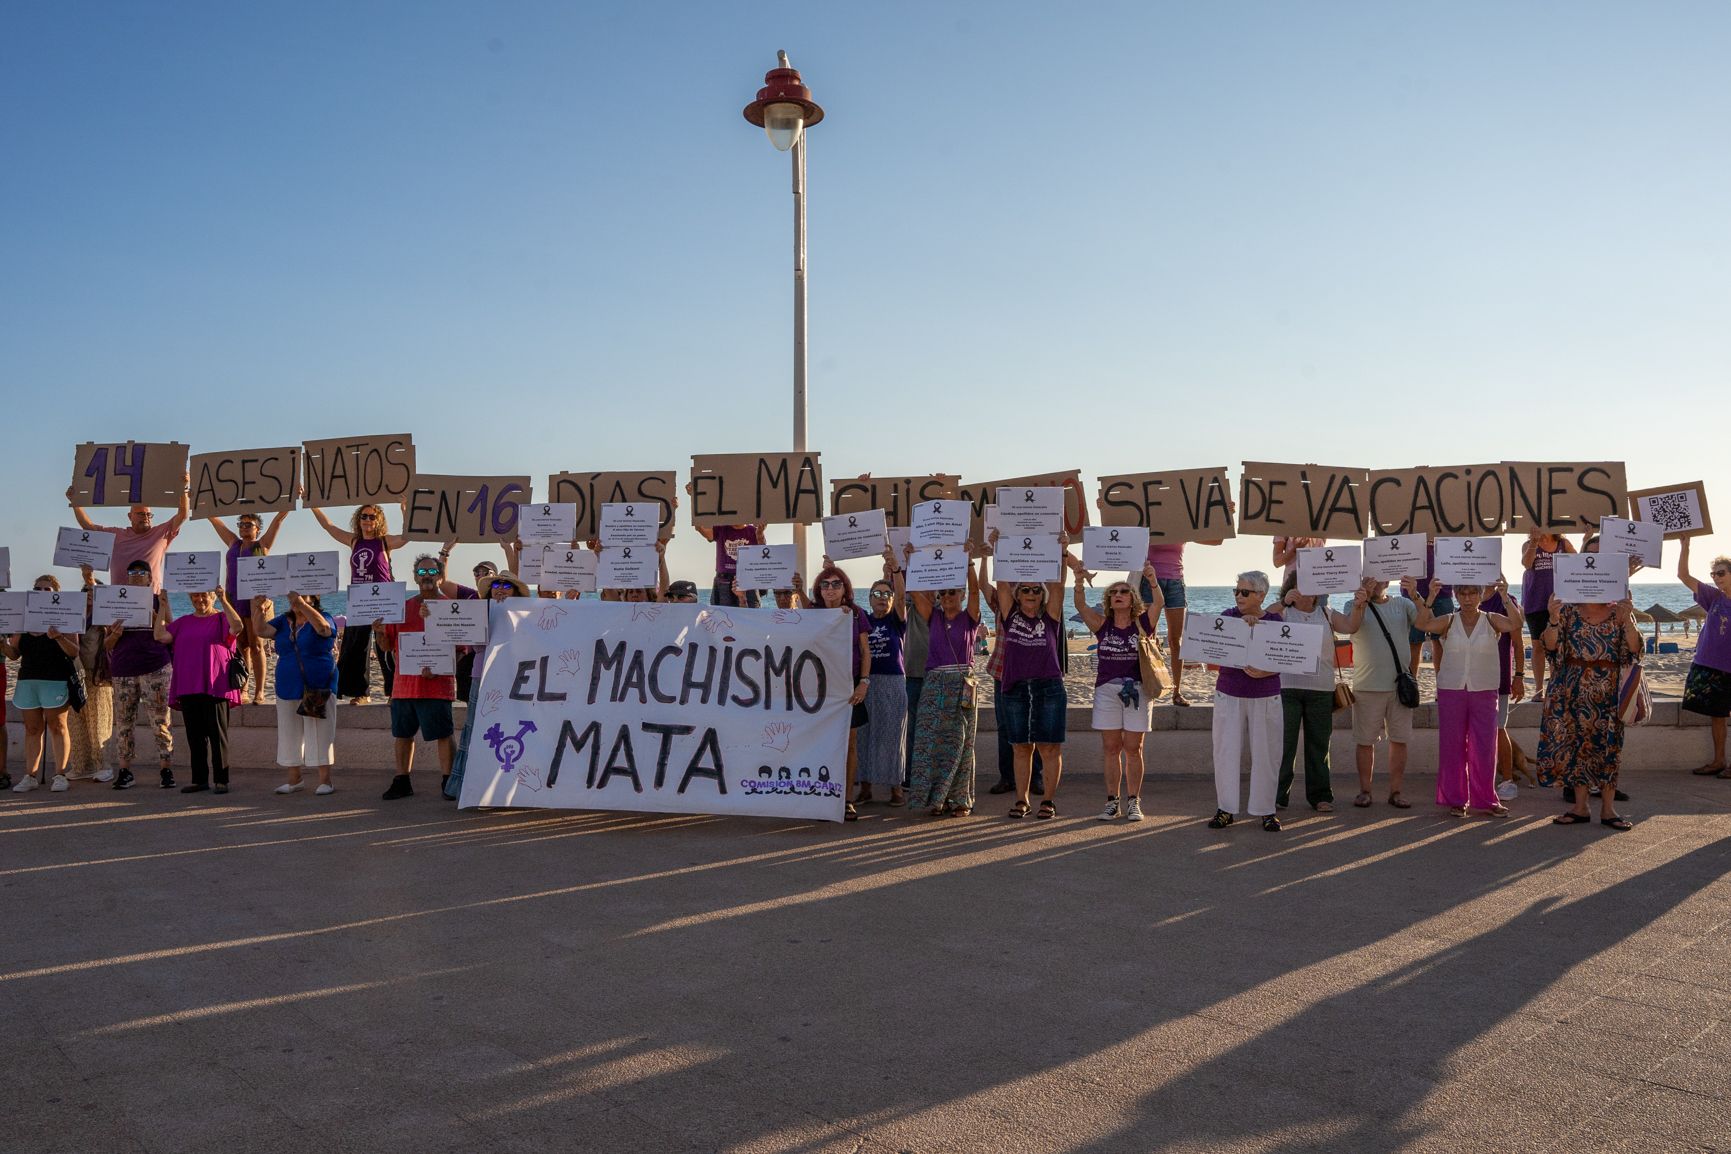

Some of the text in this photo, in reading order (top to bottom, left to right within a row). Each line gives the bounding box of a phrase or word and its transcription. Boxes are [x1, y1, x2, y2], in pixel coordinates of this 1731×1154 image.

[84, 443, 146, 505] 14
[693, 476, 738, 518] EL
[408, 488, 462, 535] EN
[467, 483, 520, 536] 16
[1104, 476, 1232, 537] SE VA
[1243, 479, 1288, 524] DE
[509, 655, 567, 702] EL
[546, 719, 728, 795] MATA
[740, 779, 793, 789] COMISION
[796, 779, 812, 789] 8M
